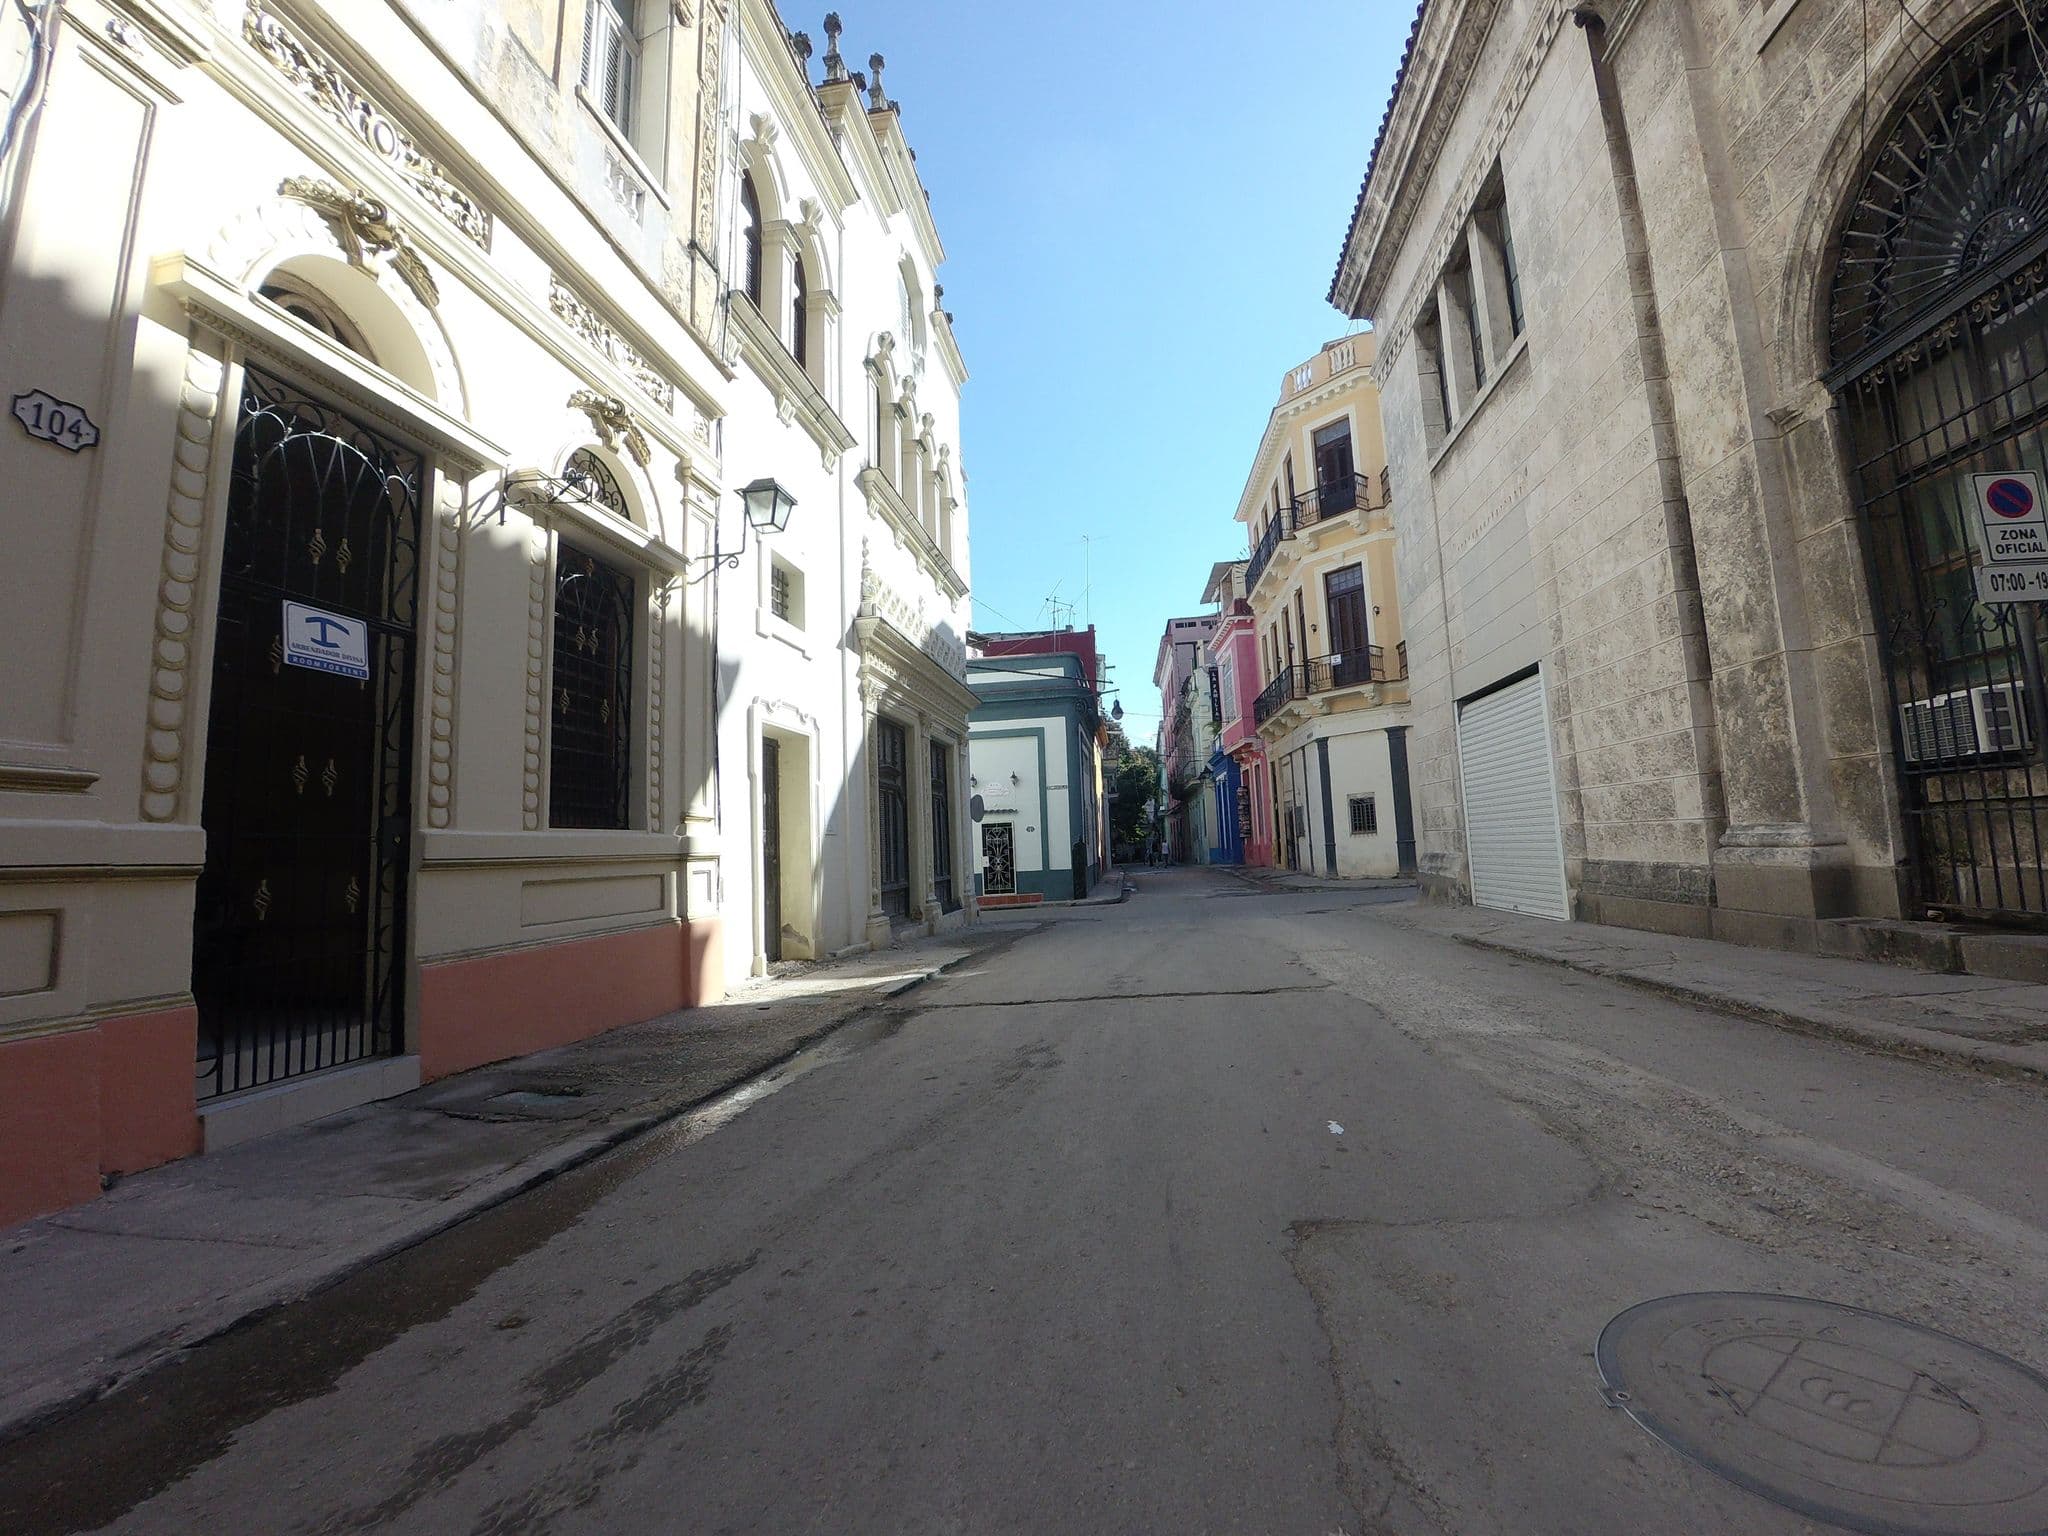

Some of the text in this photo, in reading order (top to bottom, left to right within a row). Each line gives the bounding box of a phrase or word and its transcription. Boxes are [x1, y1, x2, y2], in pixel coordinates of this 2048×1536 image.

[31, 402, 82, 443] 104
[2000, 528, 2038, 541] ZONA
[1995, 542, 2047, 554] OFICIAL
[293, 656, 320, 666] ROOM
